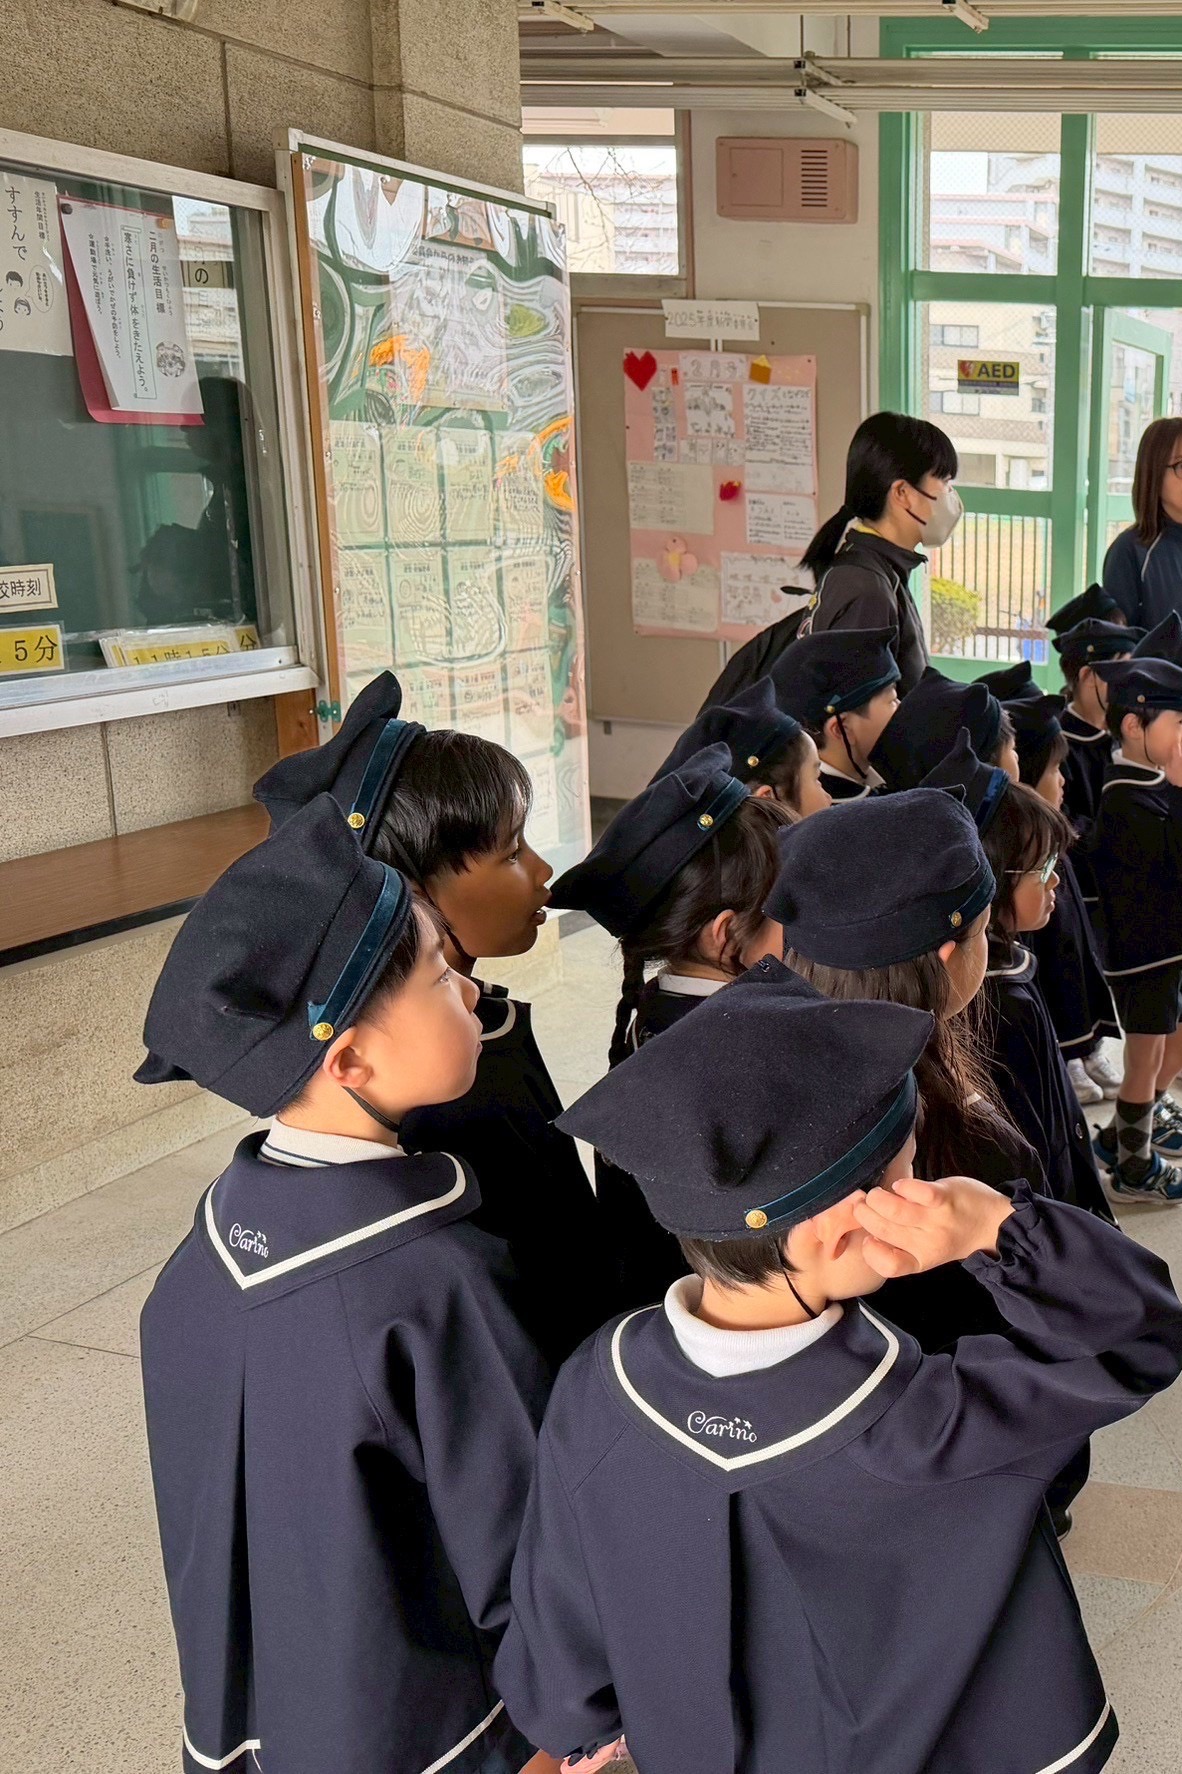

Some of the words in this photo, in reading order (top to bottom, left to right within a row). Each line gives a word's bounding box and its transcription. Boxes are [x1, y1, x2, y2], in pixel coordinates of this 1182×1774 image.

[148, 231, 166, 314] 二月の生活目標
[977, 363, 1016, 379] AED
[228, 1222, 269, 1259] Carino
[687, 1410, 758, 1443] Carino
